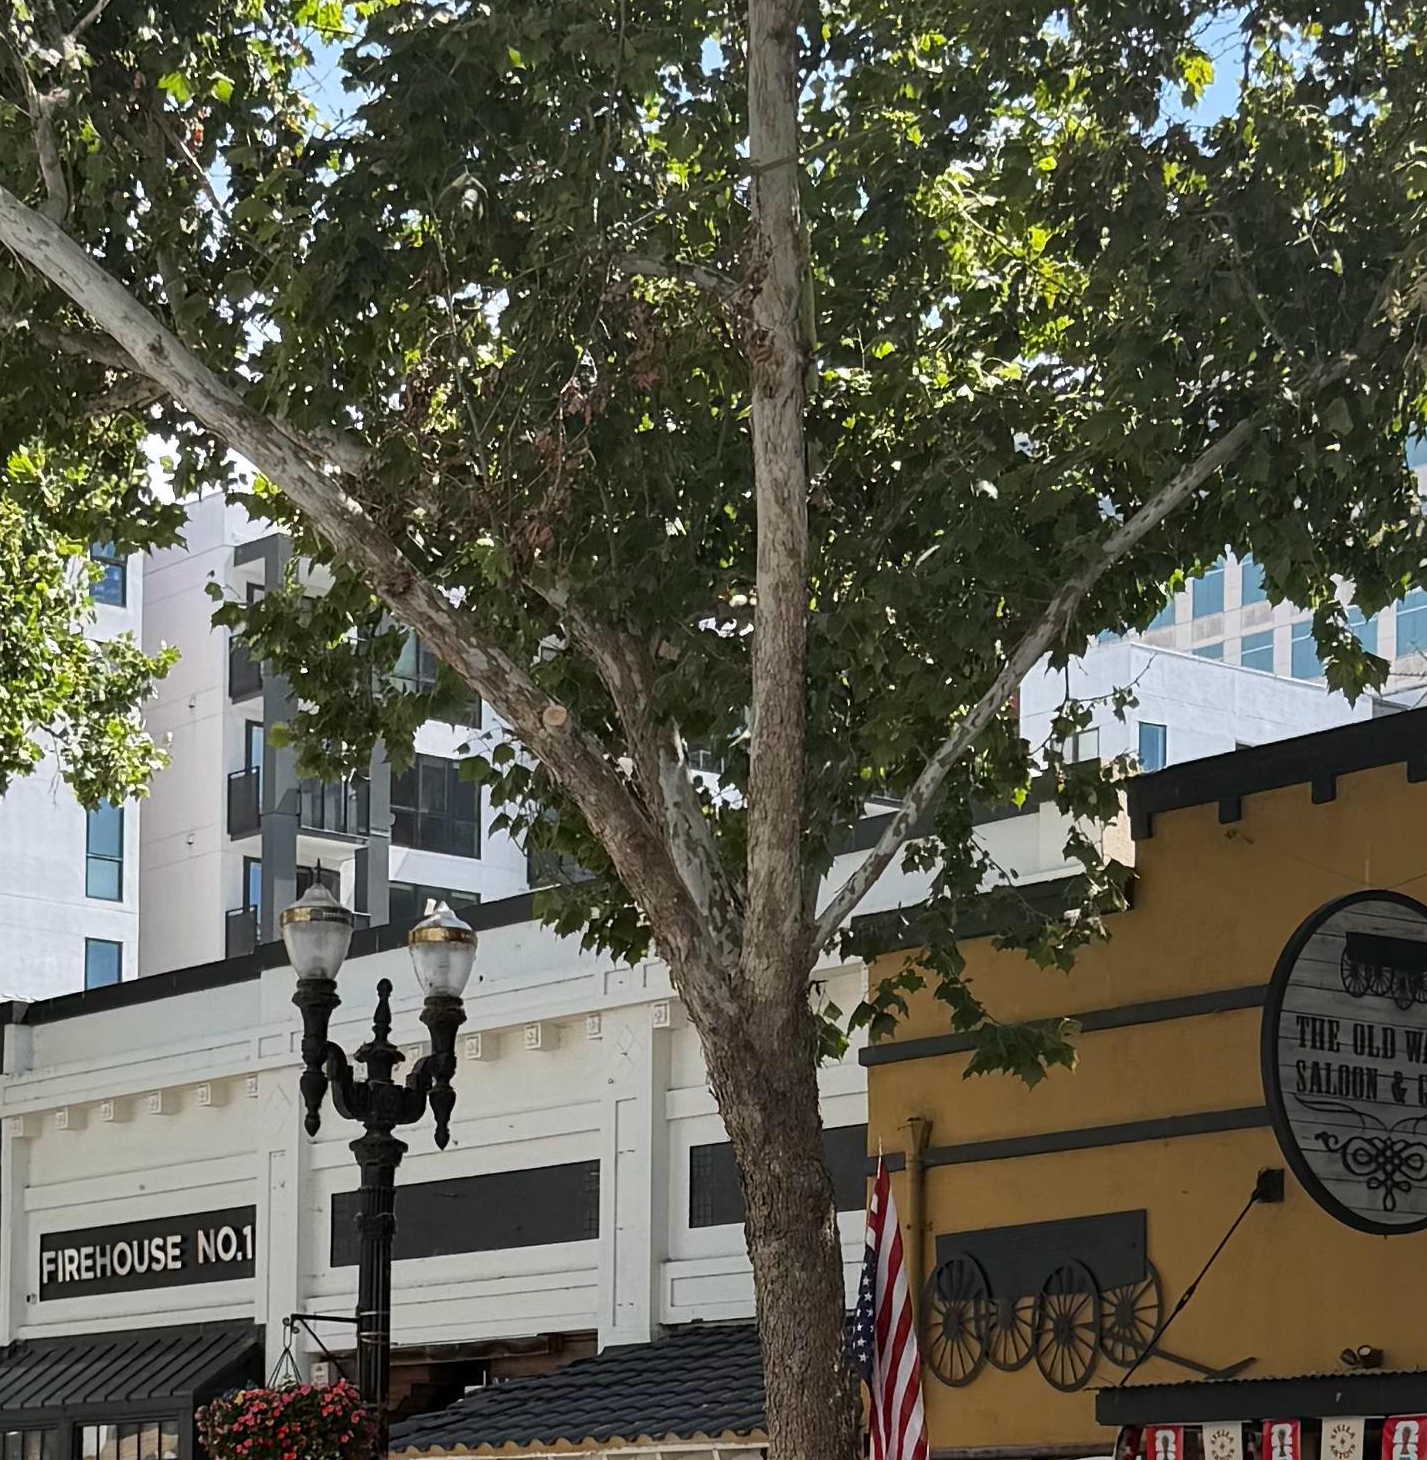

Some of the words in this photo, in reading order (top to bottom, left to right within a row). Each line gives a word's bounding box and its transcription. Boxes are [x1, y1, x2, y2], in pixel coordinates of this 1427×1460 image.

[1296, 1015, 1341, 1053] THE
[1353, 1023, 1396, 1059] OLD
[1296, 1059, 1378, 1100] SALOON
[1391, 1071, 1408, 1104] &
[42, 1234, 182, 1284] FIREHOUSE
[197, 1225, 253, 1264] NO.1
